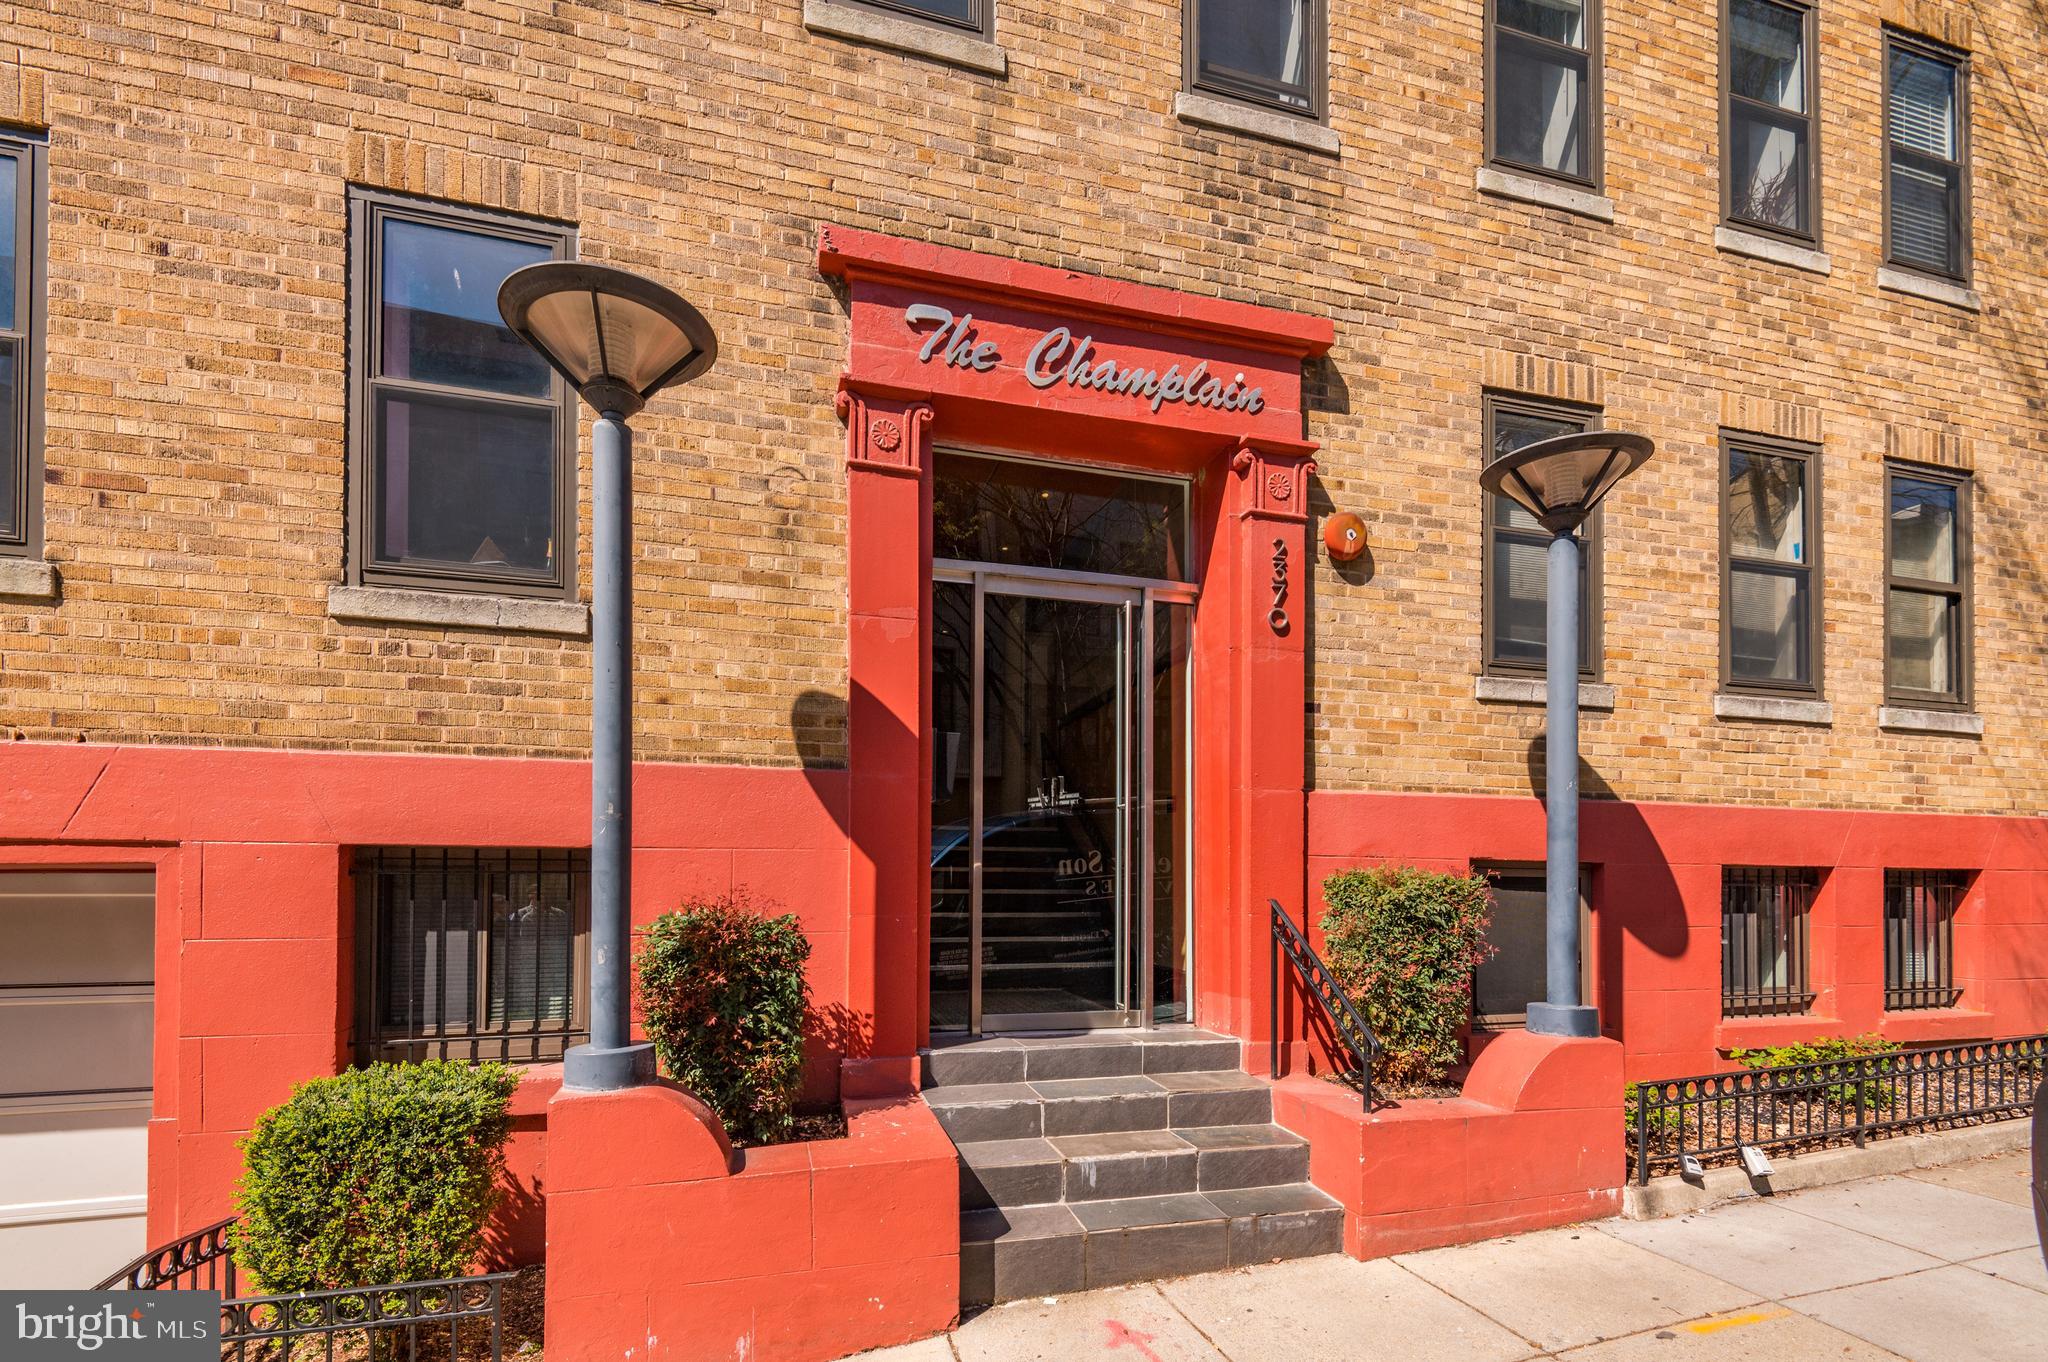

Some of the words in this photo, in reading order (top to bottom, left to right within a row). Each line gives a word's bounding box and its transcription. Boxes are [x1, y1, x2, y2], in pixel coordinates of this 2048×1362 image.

[905, 303, 998, 370] The
[1024, 326, 1265, 413] Champlain
[1267, 537, 1288, 629] 2370
